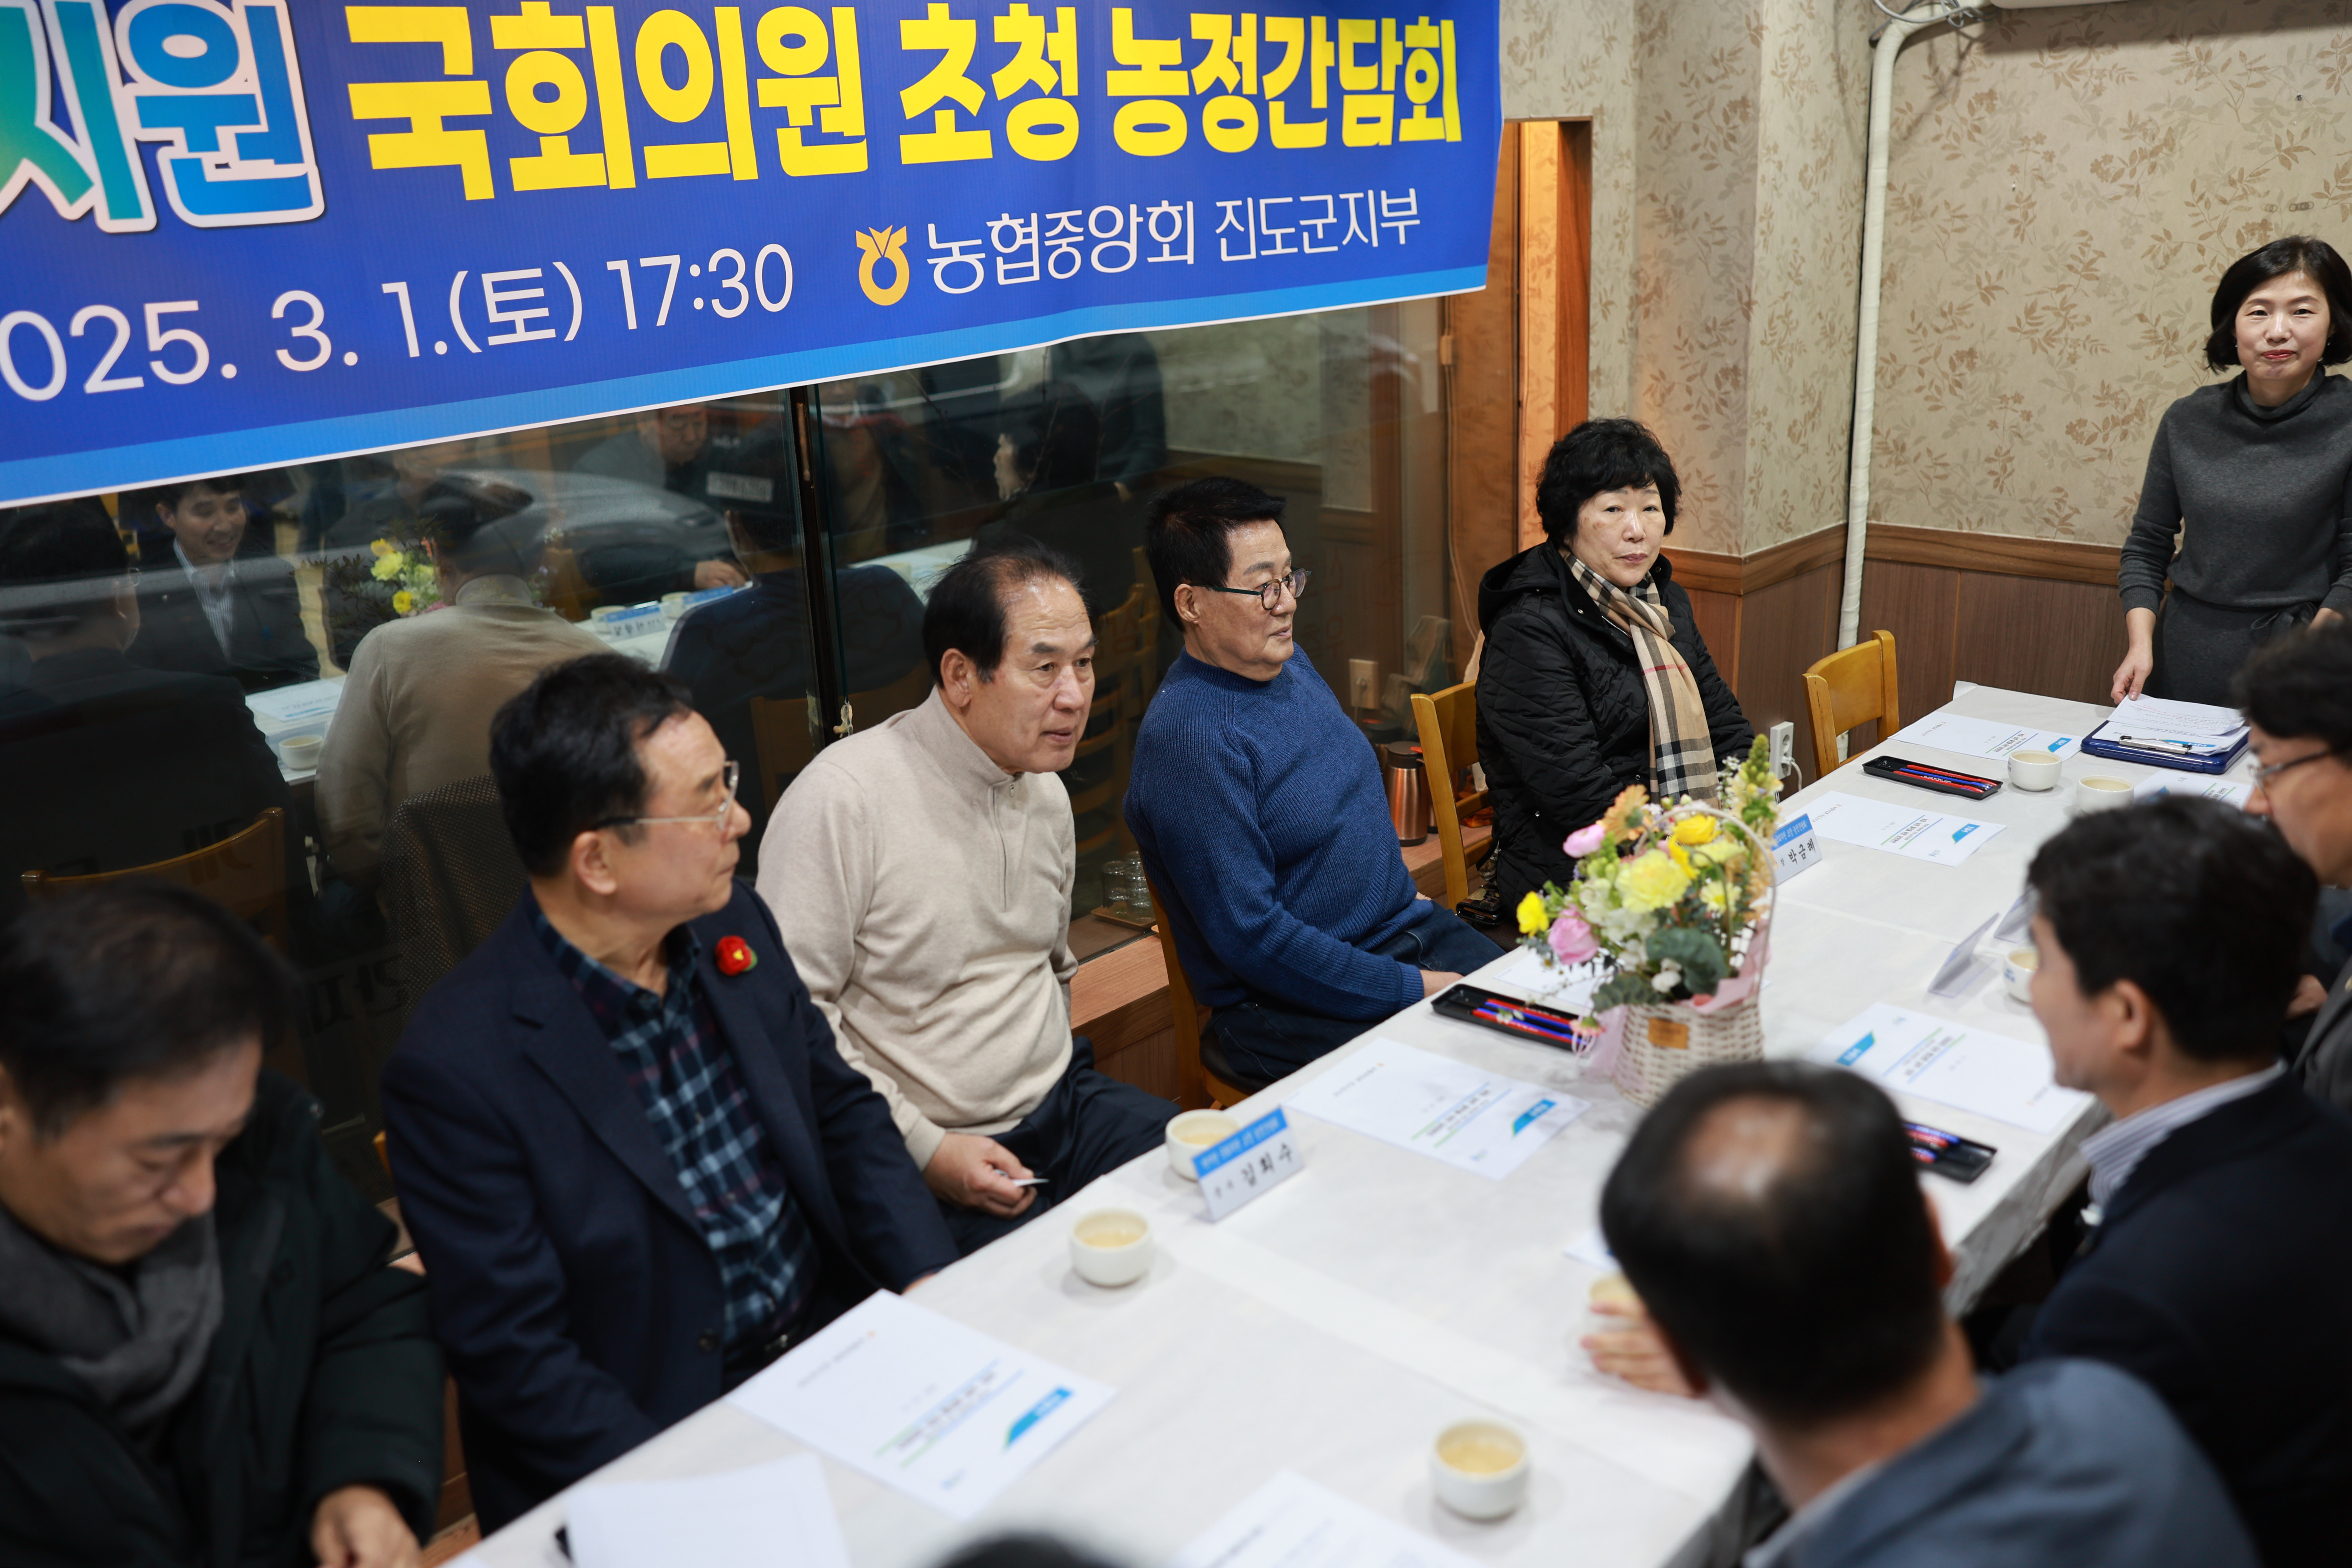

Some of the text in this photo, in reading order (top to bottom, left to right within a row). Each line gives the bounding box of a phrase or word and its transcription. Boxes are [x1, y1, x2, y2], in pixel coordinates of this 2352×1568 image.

[346, 2, 868, 200] 국회의원
[900, 3, 1079, 164] 초청
[1107, 8, 1461, 156] 농정간담회
[927, 188, 1420, 294] 농협중앙회 진도군지부
[272, 290, 358, 371] 3.
[382, 261, 582, 358] 1.(토)
[607, 244, 793, 330] 17:30
